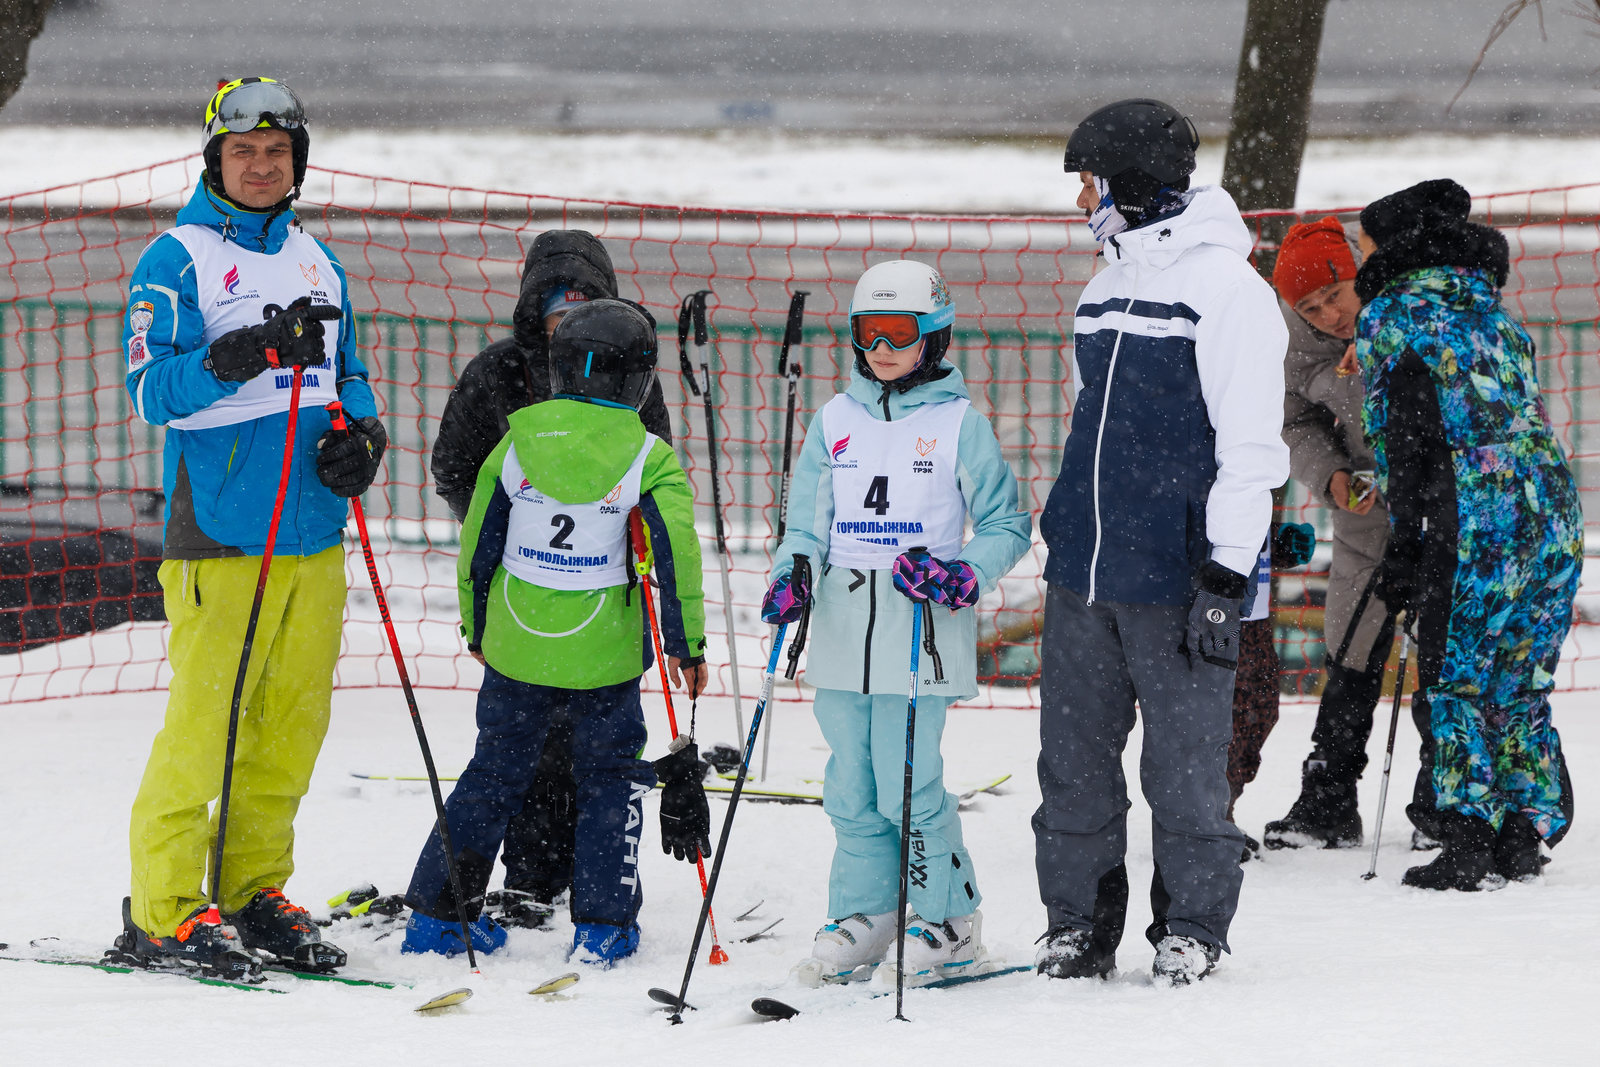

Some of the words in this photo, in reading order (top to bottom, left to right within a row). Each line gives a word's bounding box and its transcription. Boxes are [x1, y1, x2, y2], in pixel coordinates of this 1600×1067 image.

[780, 471, 790, 523] ATOMIC
[864, 476, 890, 516] 4
[549, 514, 575, 551] 2
[836, 521, 924, 534] ГОРНОЛЫЖНАЯ
[518, 545, 609, 567] ГОРНОЛЫЖНАЯ
[185, 945, 197, 953] RX
[950, 935, 971, 956] HEAD
